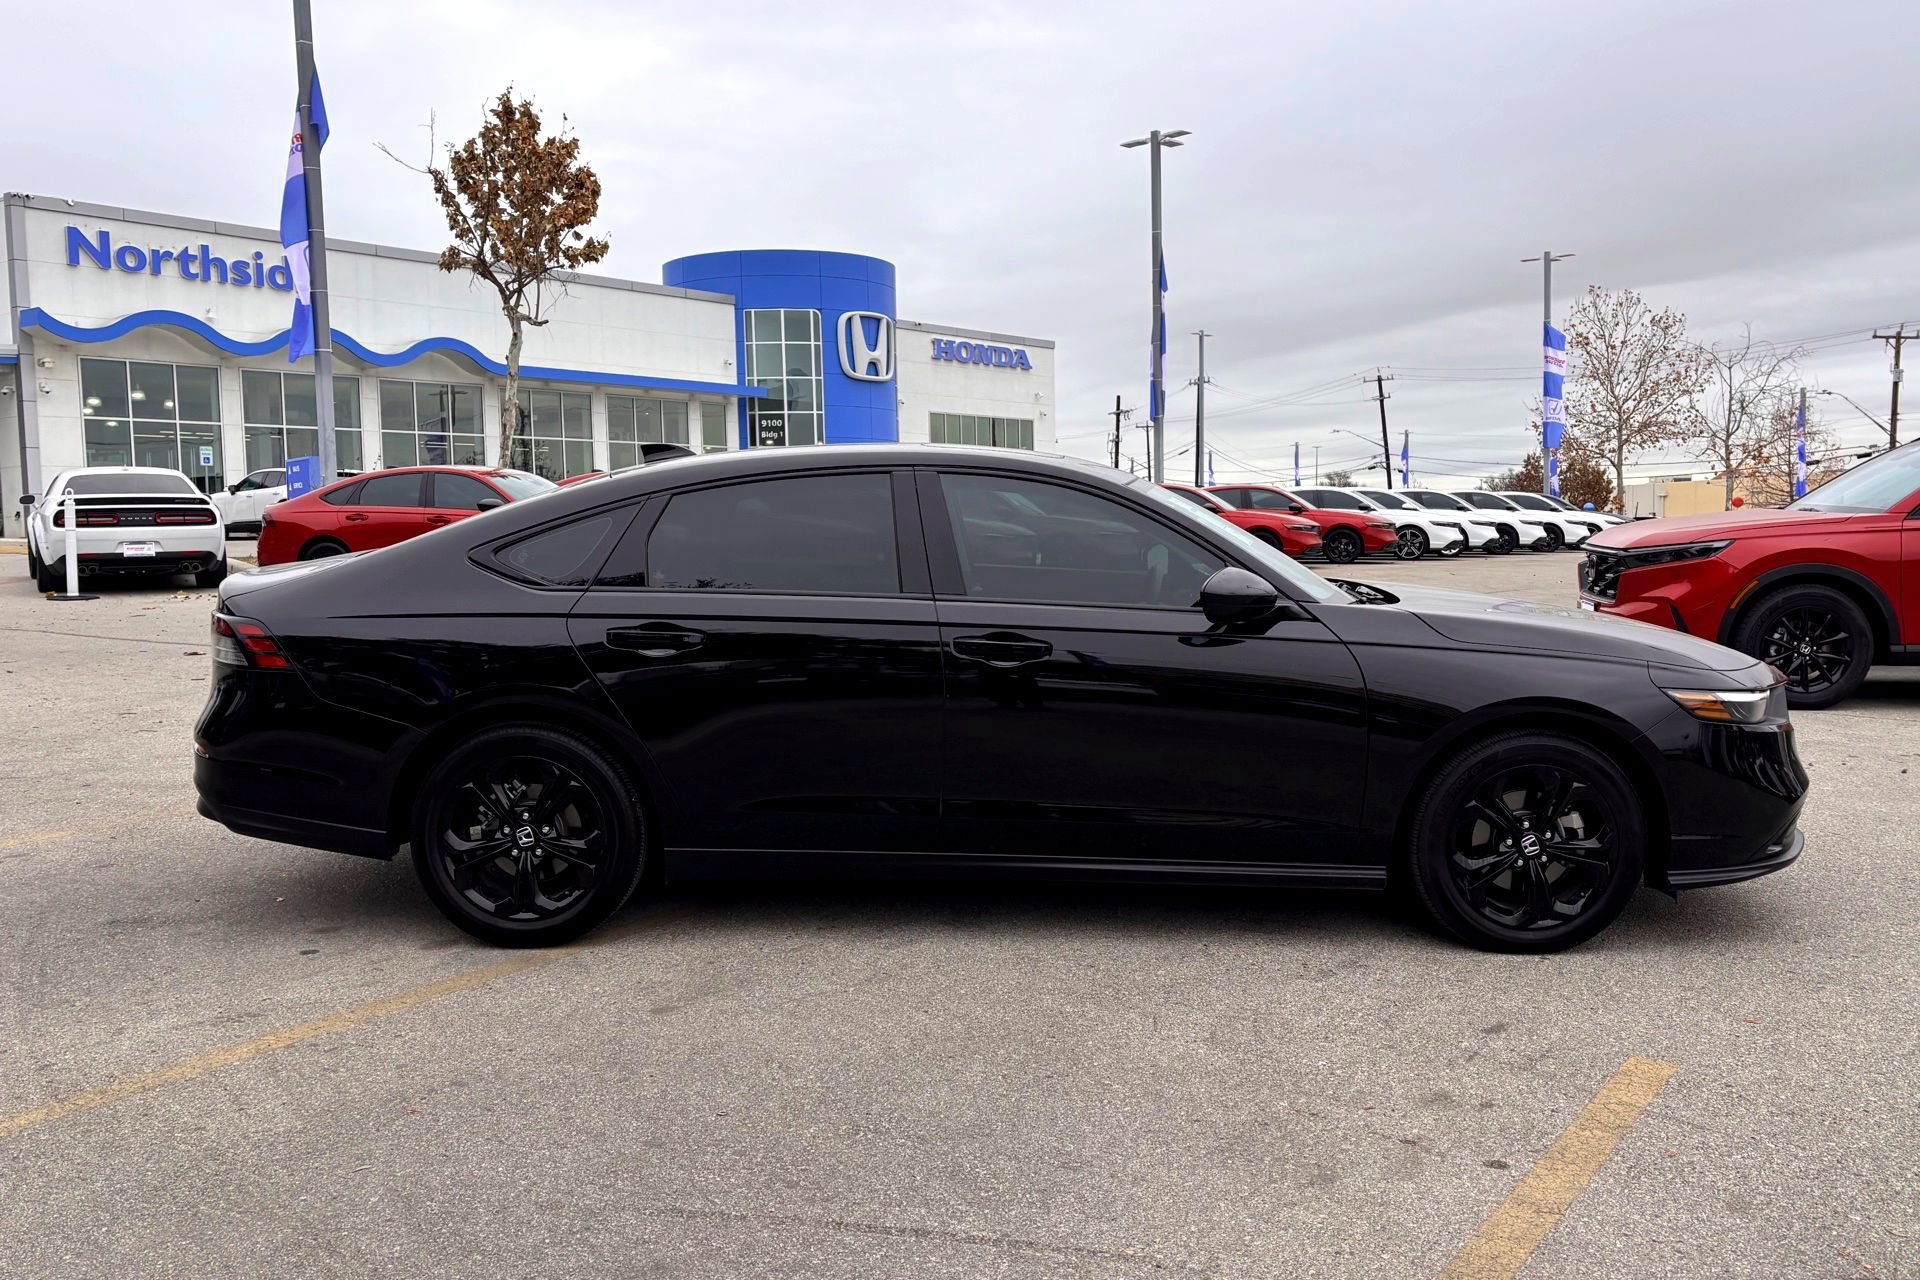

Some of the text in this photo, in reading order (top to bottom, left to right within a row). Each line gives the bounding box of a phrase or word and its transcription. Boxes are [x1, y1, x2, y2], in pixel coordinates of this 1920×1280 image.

[64, 224, 295, 291] Northsid
[931, 337, 1033, 370] HONDA
[761, 419, 783, 428] 9100
[761, 431, 778, 439] Bldg
